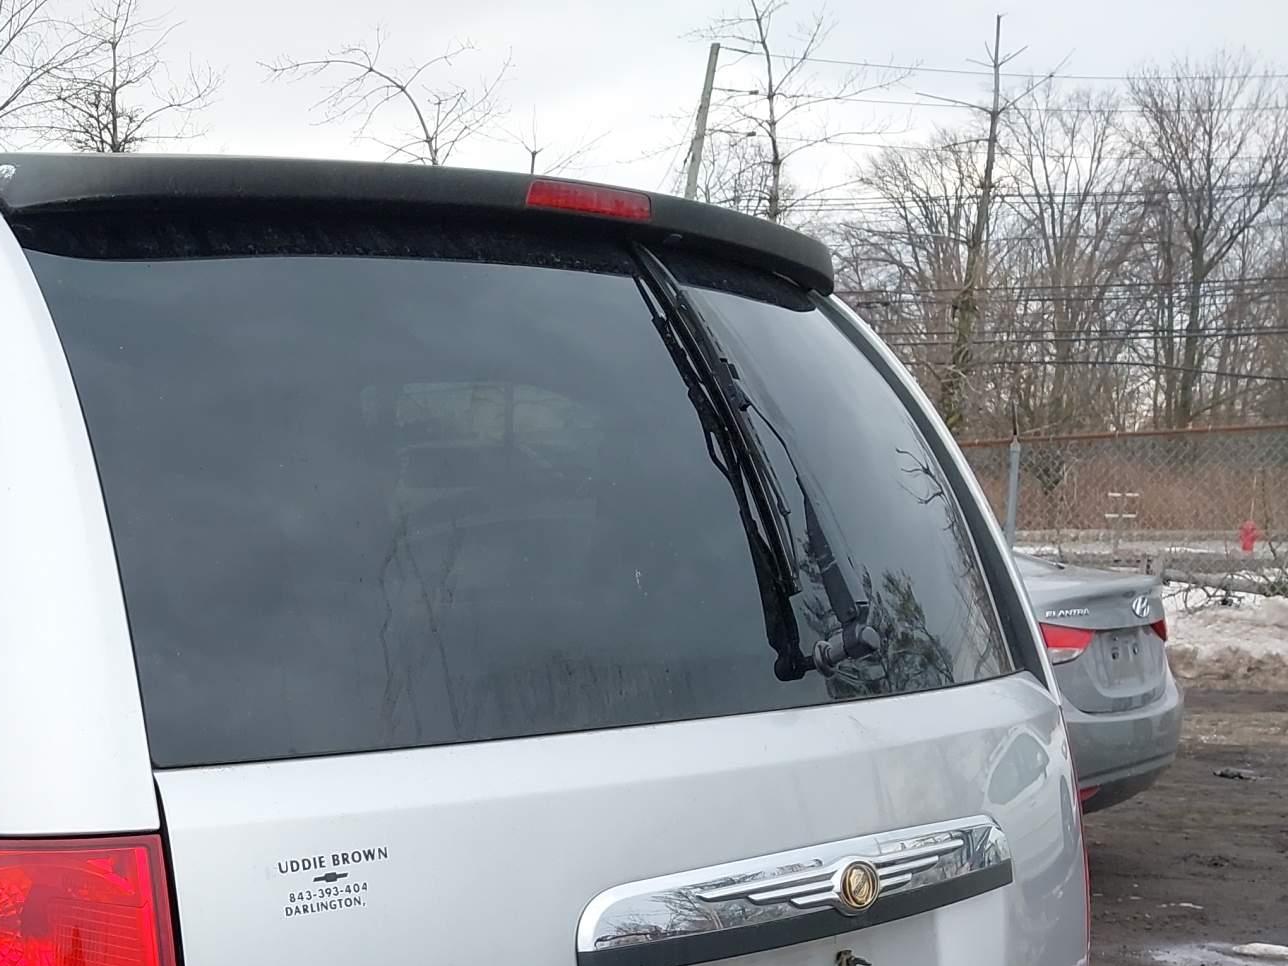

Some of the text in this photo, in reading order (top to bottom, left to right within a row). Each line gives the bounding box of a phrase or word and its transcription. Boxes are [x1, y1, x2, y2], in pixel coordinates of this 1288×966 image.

[278, 847, 388, 874] UDDIE BROWN
[289, 882, 368, 903] 843-393-404
[285, 896, 366, 917] DARLINGTON,
